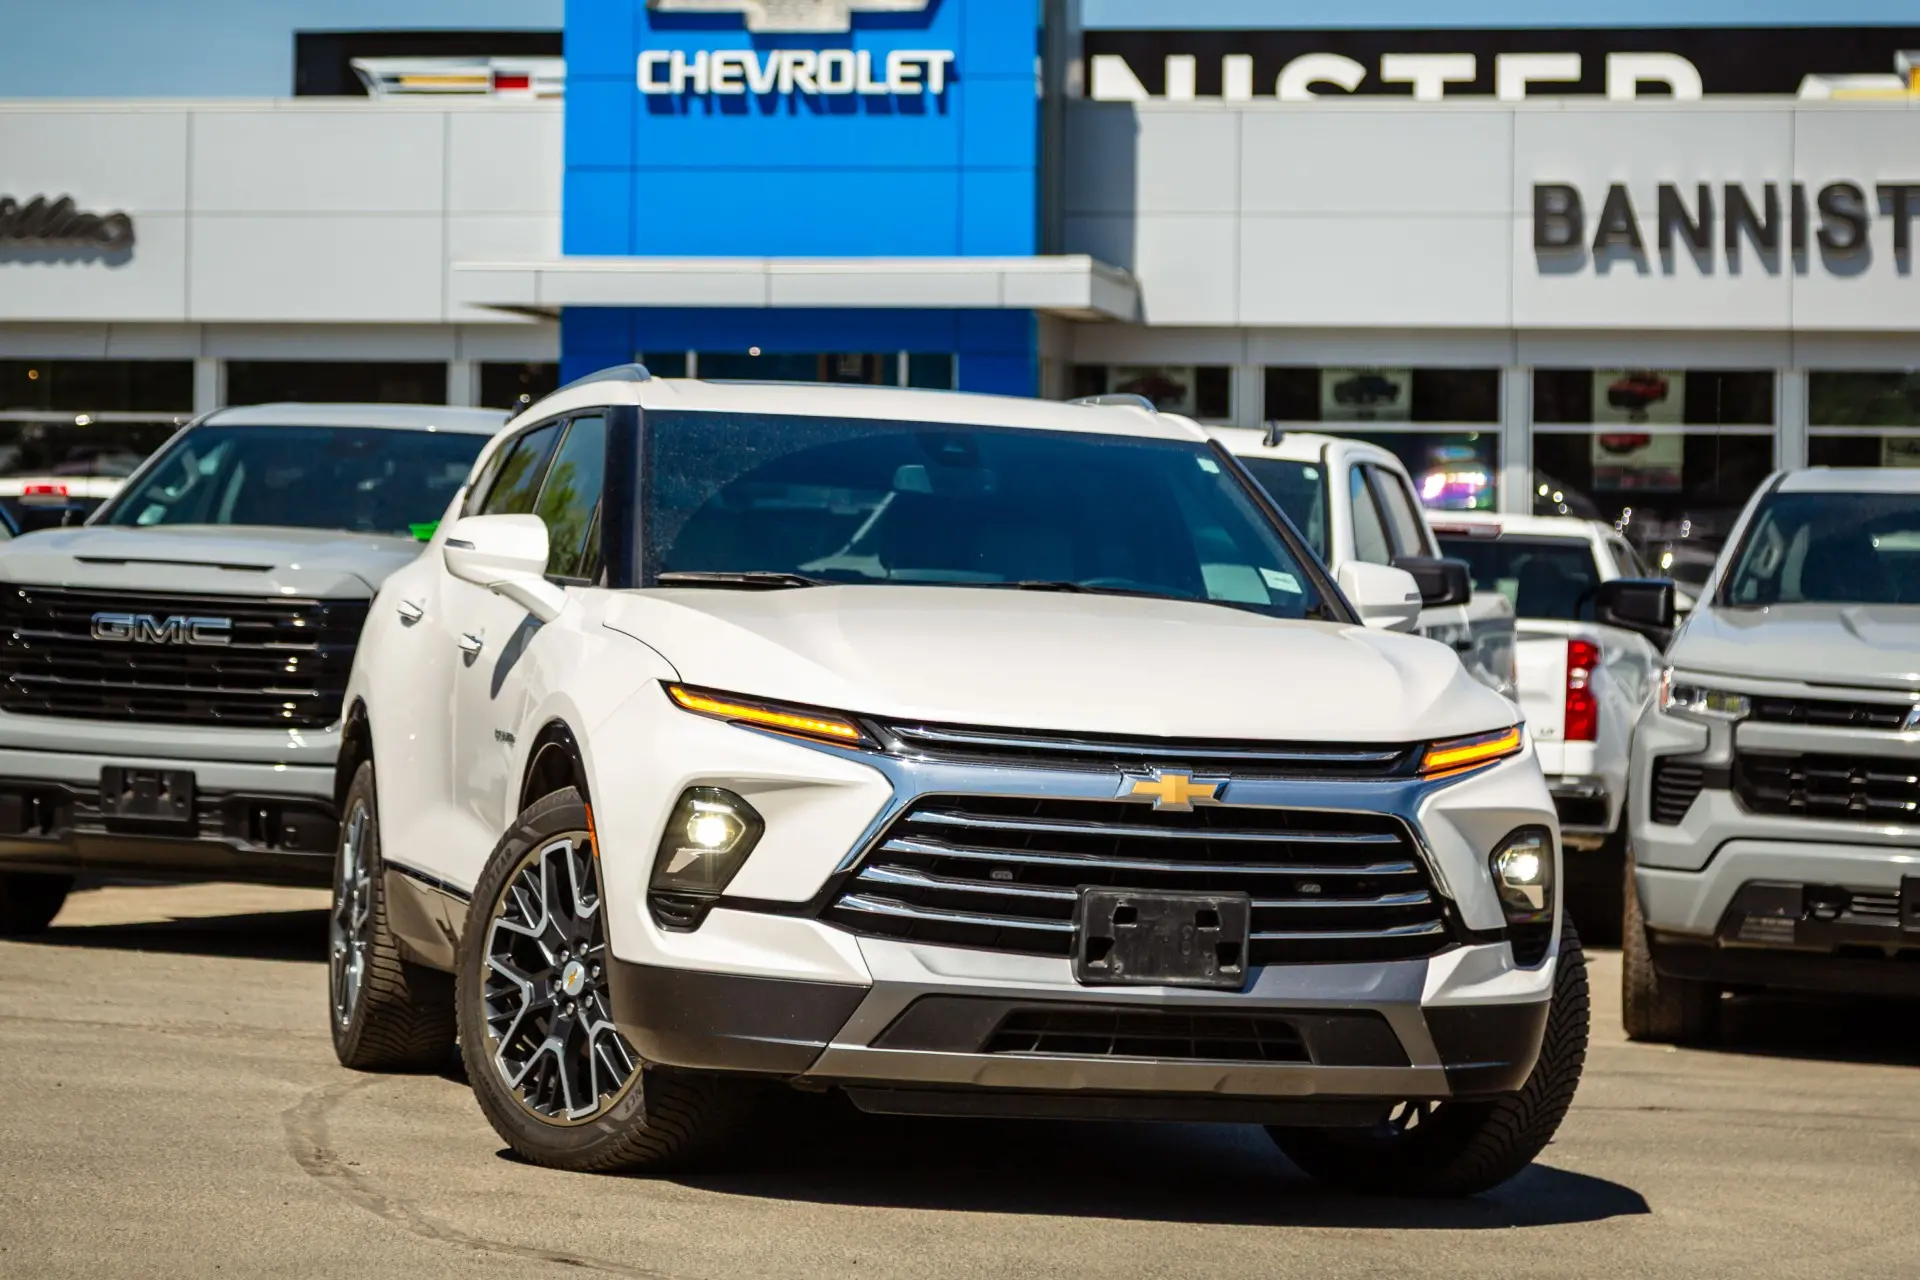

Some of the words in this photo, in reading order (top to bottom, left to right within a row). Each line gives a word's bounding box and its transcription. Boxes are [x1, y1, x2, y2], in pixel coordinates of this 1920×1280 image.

[637, 50, 955, 94] CHEVROLET
[1533, 182, 1920, 252] BANNIST
[91, 612, 232, 645] GMC
